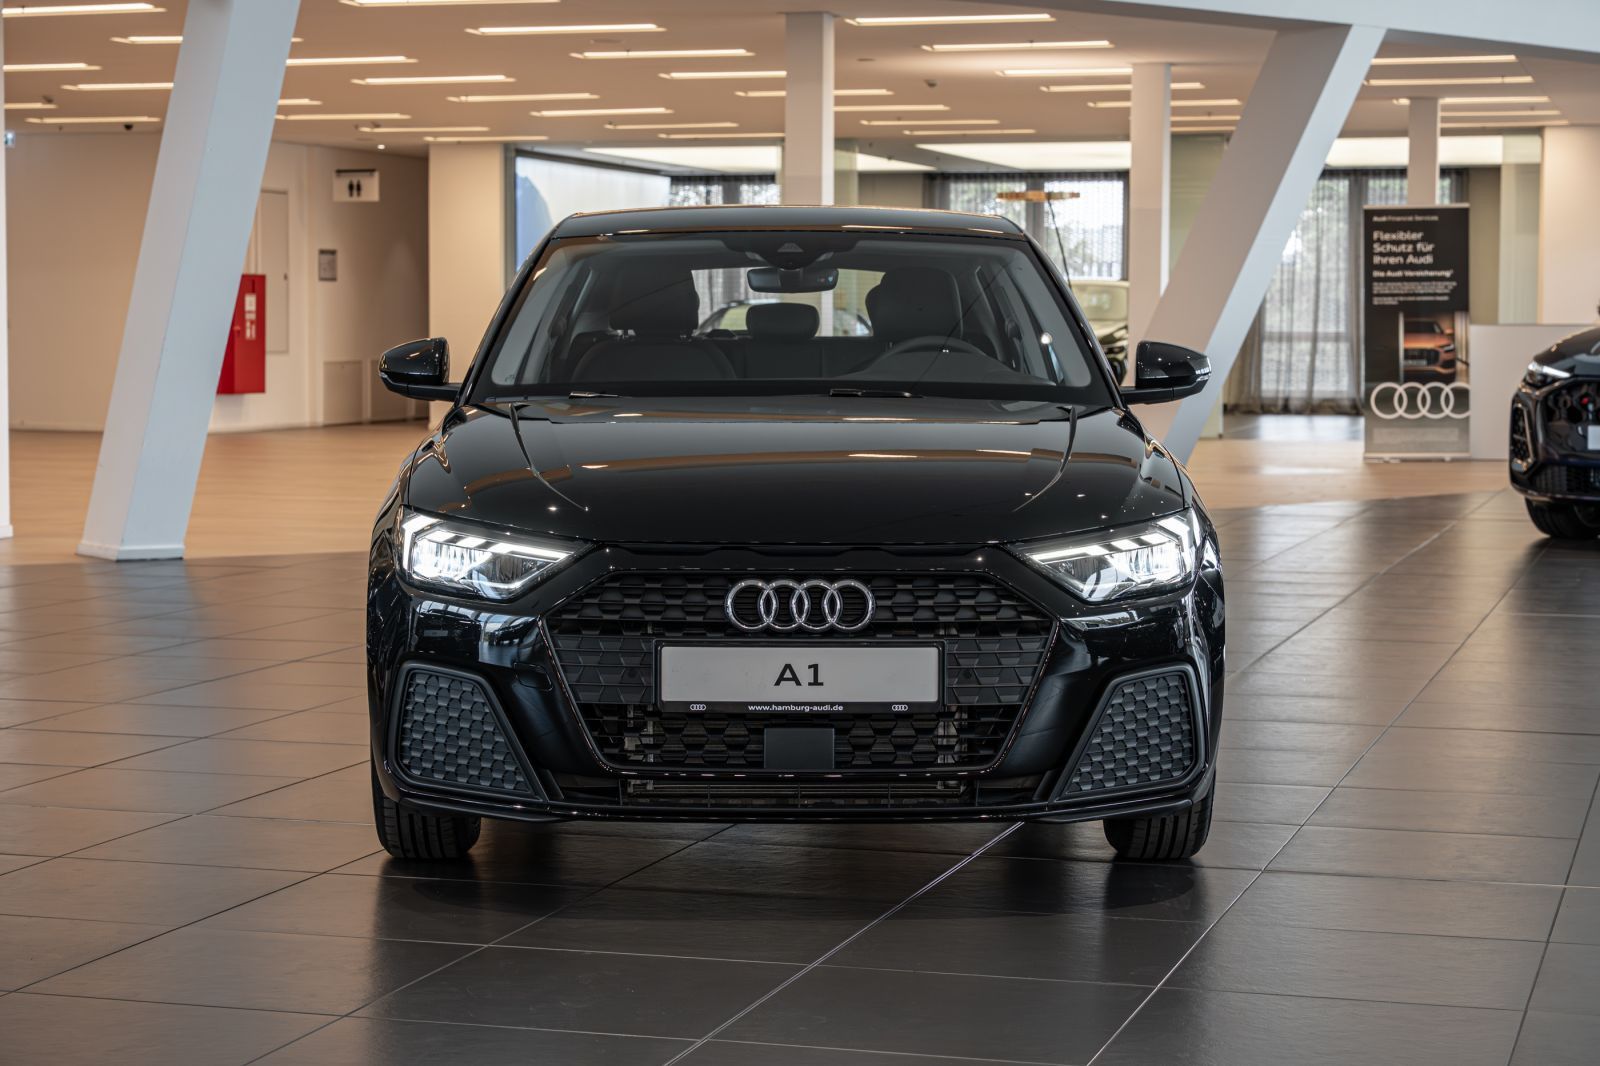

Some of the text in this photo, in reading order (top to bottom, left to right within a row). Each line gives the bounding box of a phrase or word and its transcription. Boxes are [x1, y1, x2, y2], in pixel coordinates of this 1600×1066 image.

[1373, 230, 1424, 241] Flexibler
[1373, 242, 1435, 253] Schutz für
[1373, 254, 1433, 265] Ihren Audi
[774, 663, 824, 686] A1
[748, 704, 844, 712] www.hamburg-audi.de
